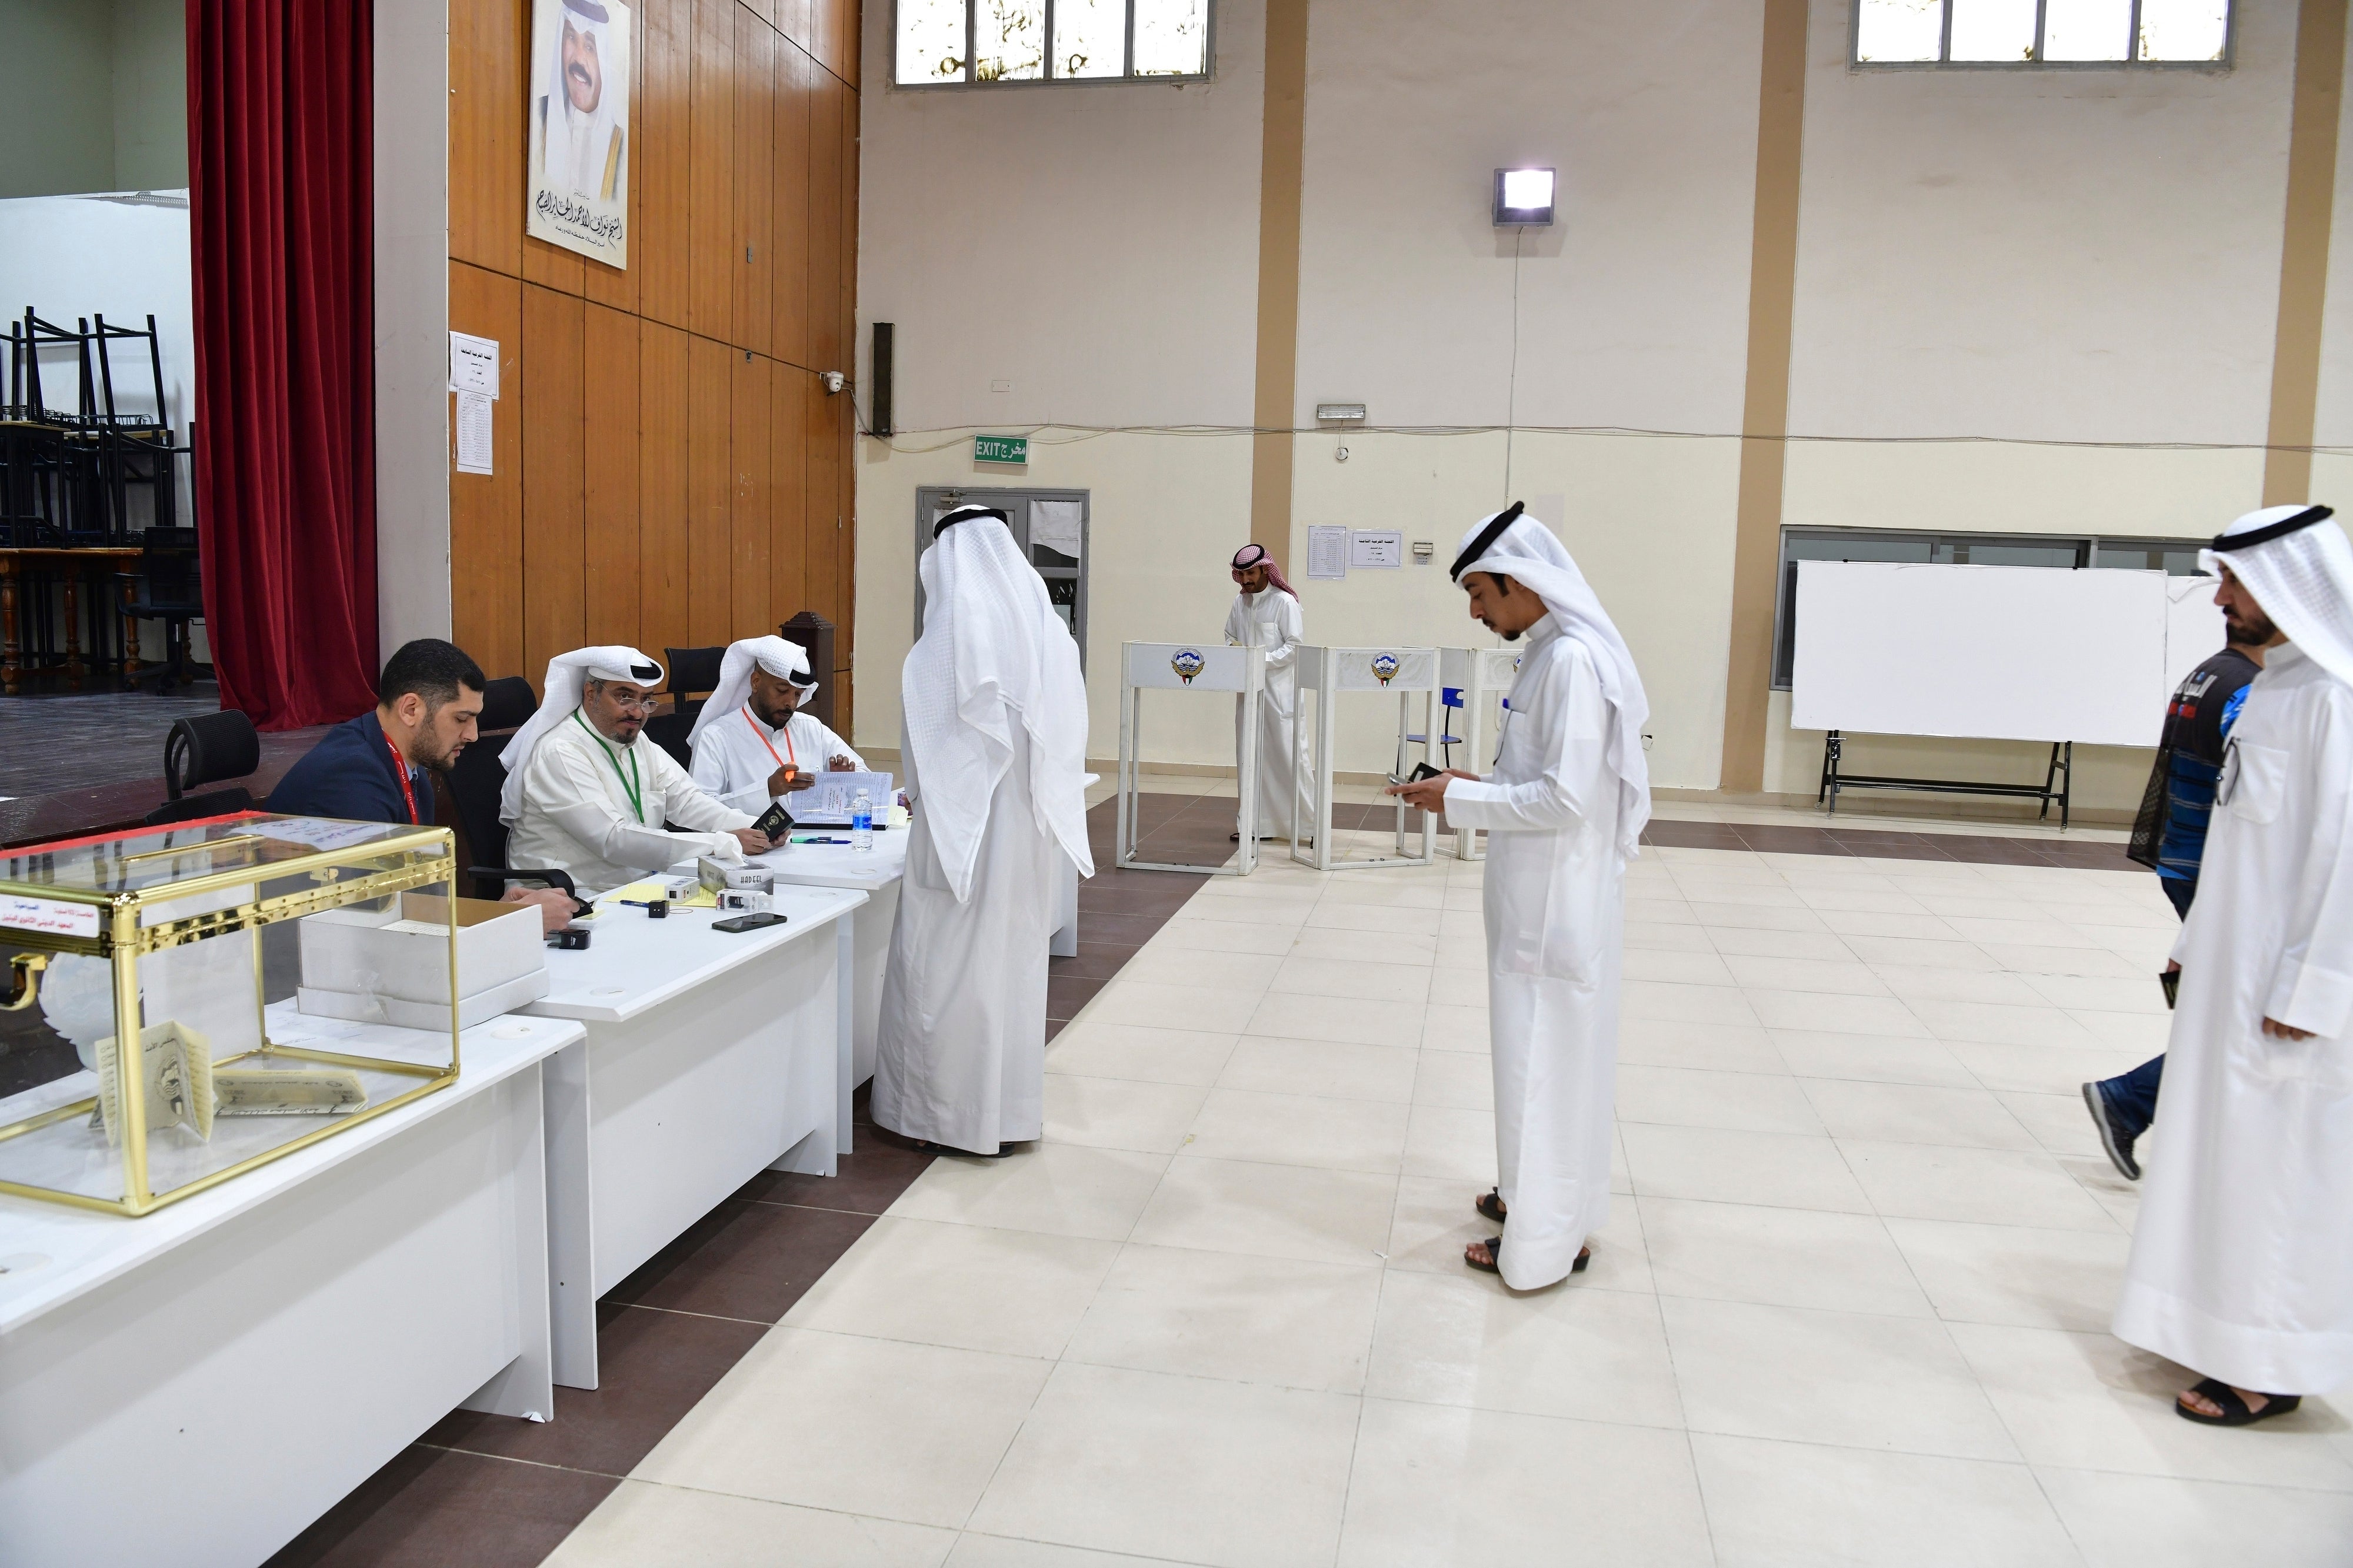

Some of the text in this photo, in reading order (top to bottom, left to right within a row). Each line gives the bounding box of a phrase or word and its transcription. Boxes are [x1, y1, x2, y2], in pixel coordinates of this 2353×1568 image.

[536, 189, 552, 222] الصباح
[590, 215, 609, 236] نواف
[608, 216, 622, 249] الشيخ
[976, 442, 1001, 456] EXIT
[1001, 442, 1025, 459] مخرج
[740, 875, 762, 884] HADEEL
